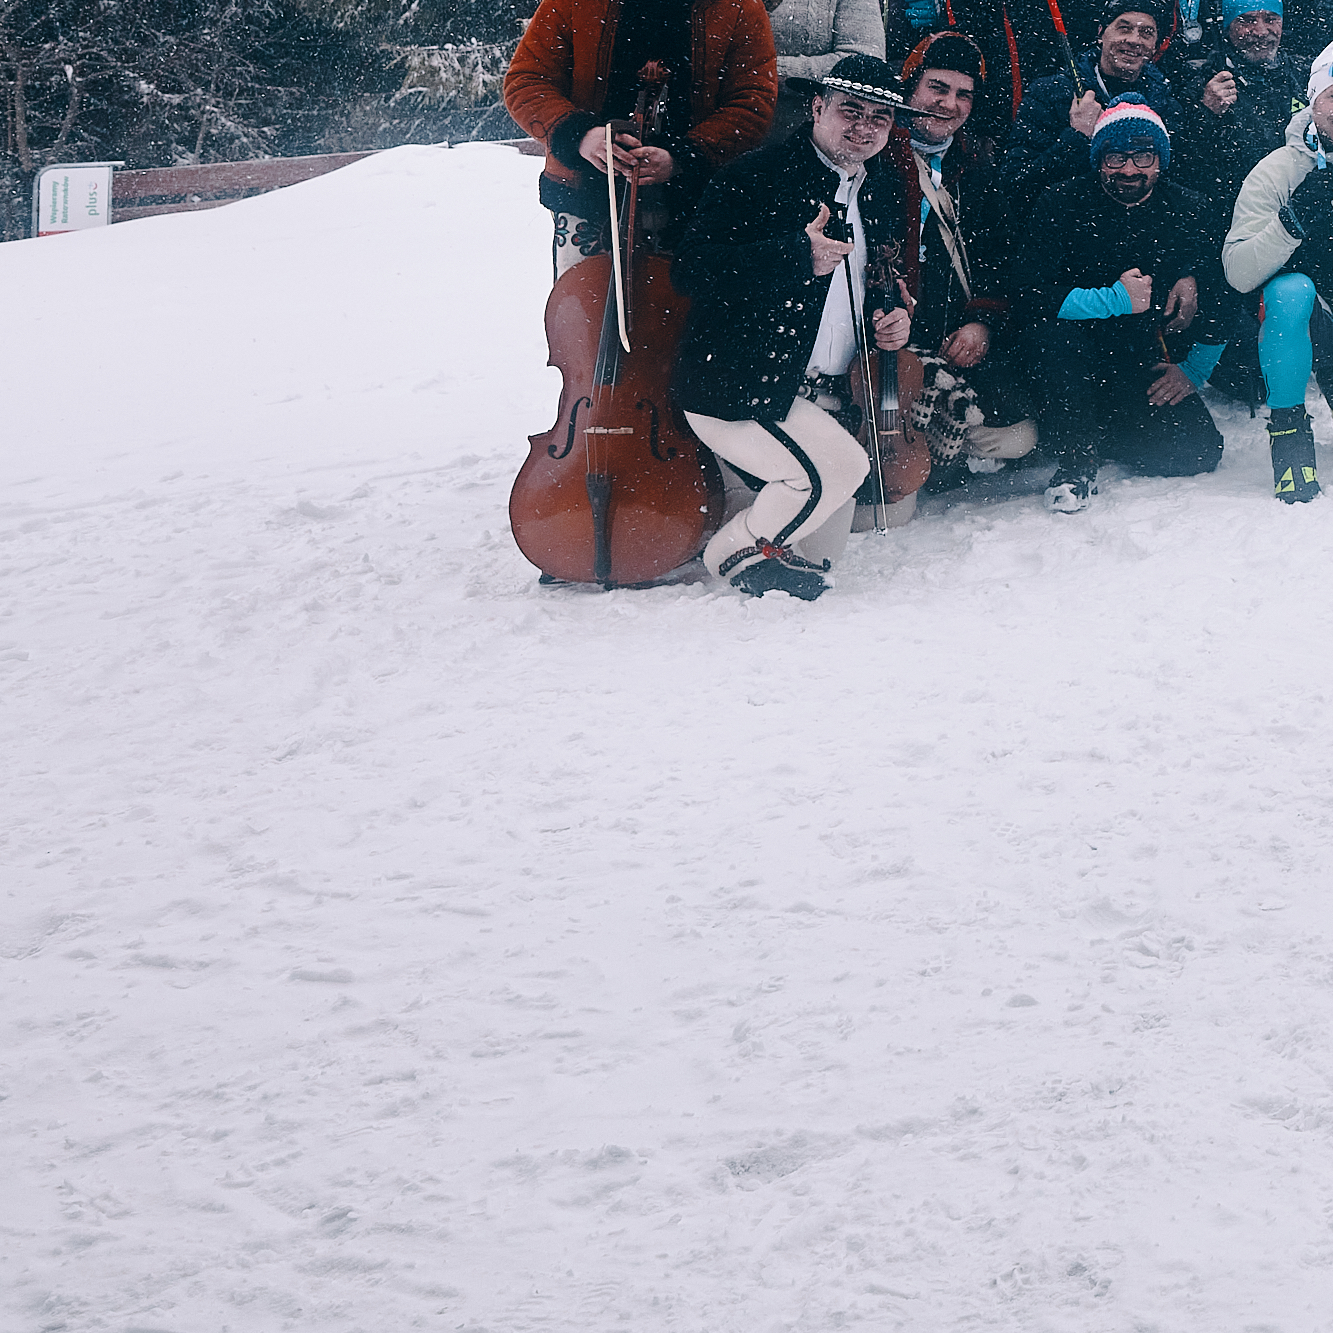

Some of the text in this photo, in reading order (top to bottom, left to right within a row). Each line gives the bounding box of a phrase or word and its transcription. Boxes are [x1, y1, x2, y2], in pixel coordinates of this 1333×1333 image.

[50, 180, 59, 224] Wspieramy
[62, 175, 71, 224] Ratowników
[87, 191, 100, 216] plus
